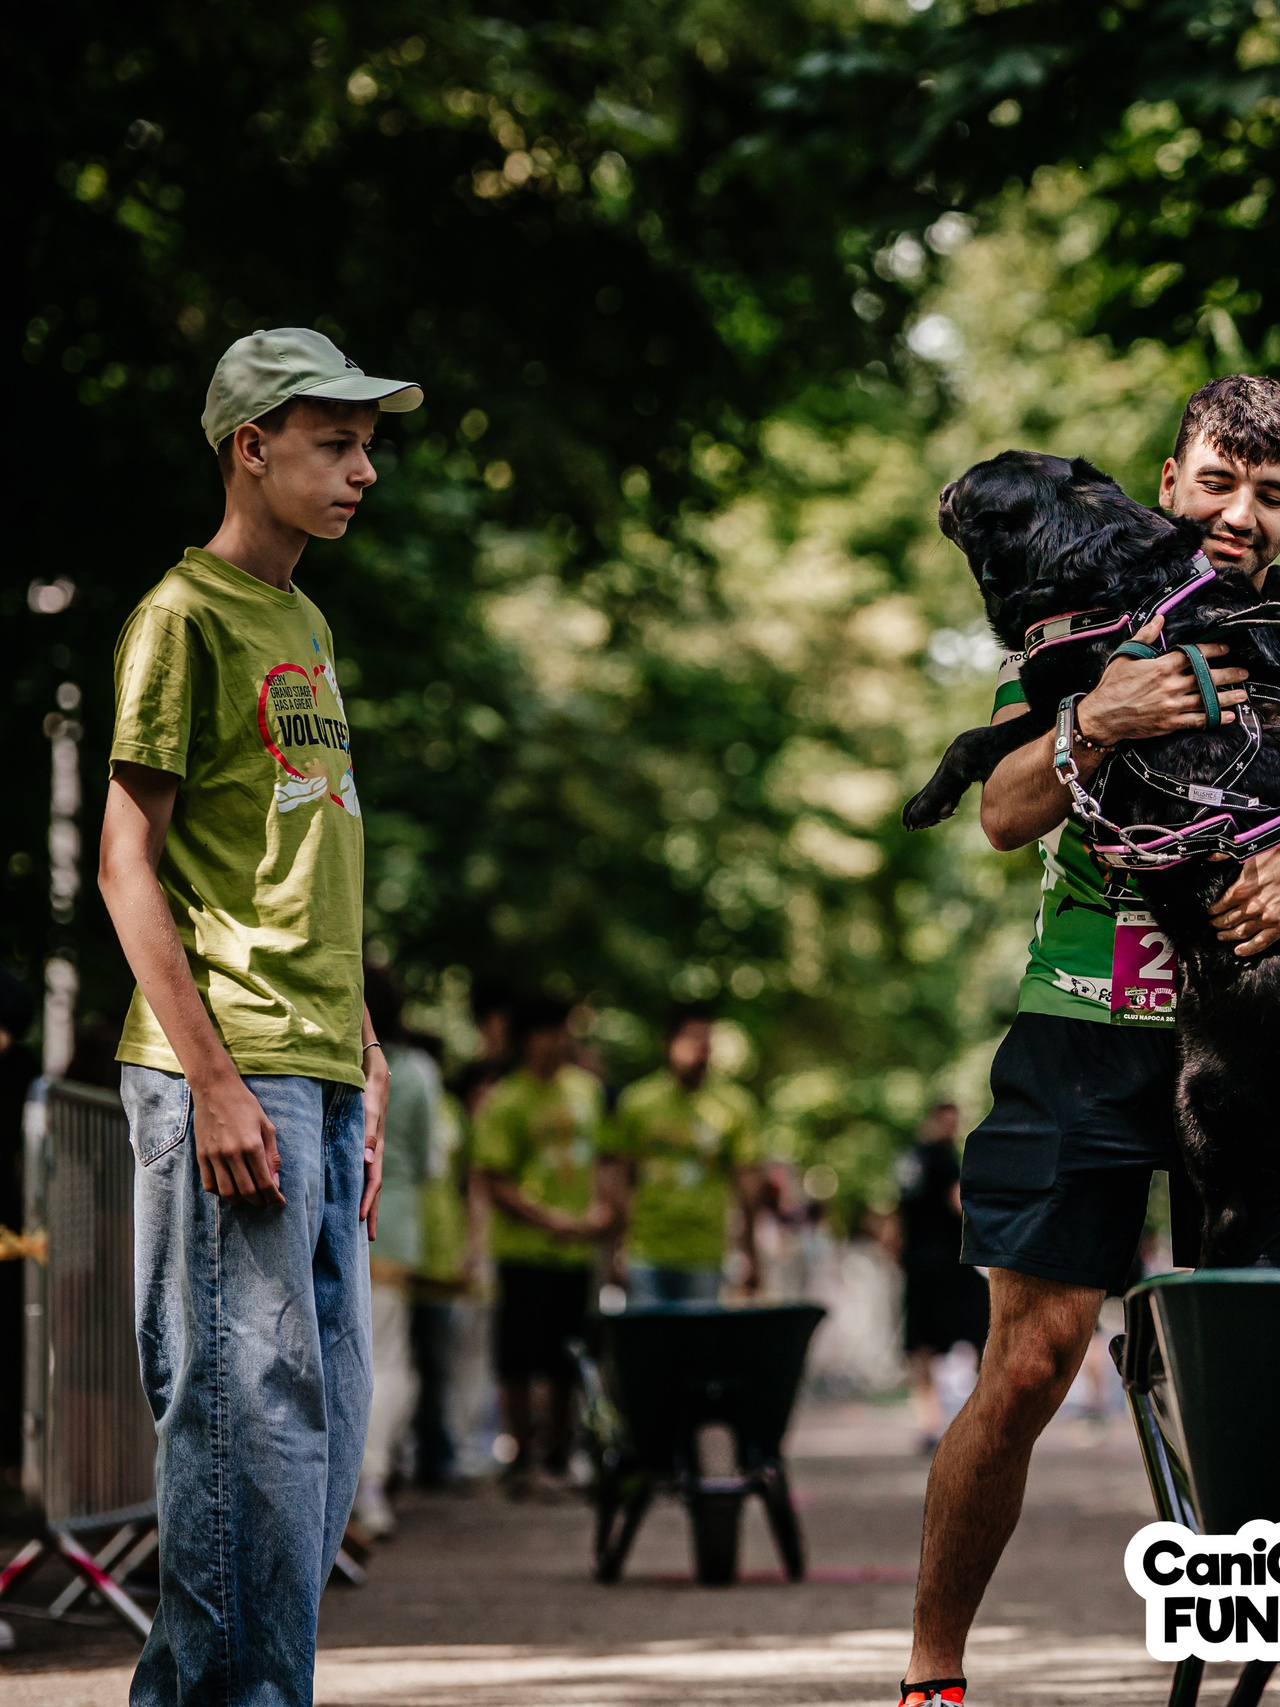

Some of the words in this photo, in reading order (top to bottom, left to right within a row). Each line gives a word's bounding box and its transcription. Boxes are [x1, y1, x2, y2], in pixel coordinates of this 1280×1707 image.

[266, 674, 286, 686] EVERY
[270, 686, 293, 699] GRAND
[293, 685, 312, 698] STAGE
[273, 699, 289, 711] HAS
[288, 699, 294, 710] A
[294, 698, 313, 709] GREAT
[1139, 931, 1174, 979] 2
